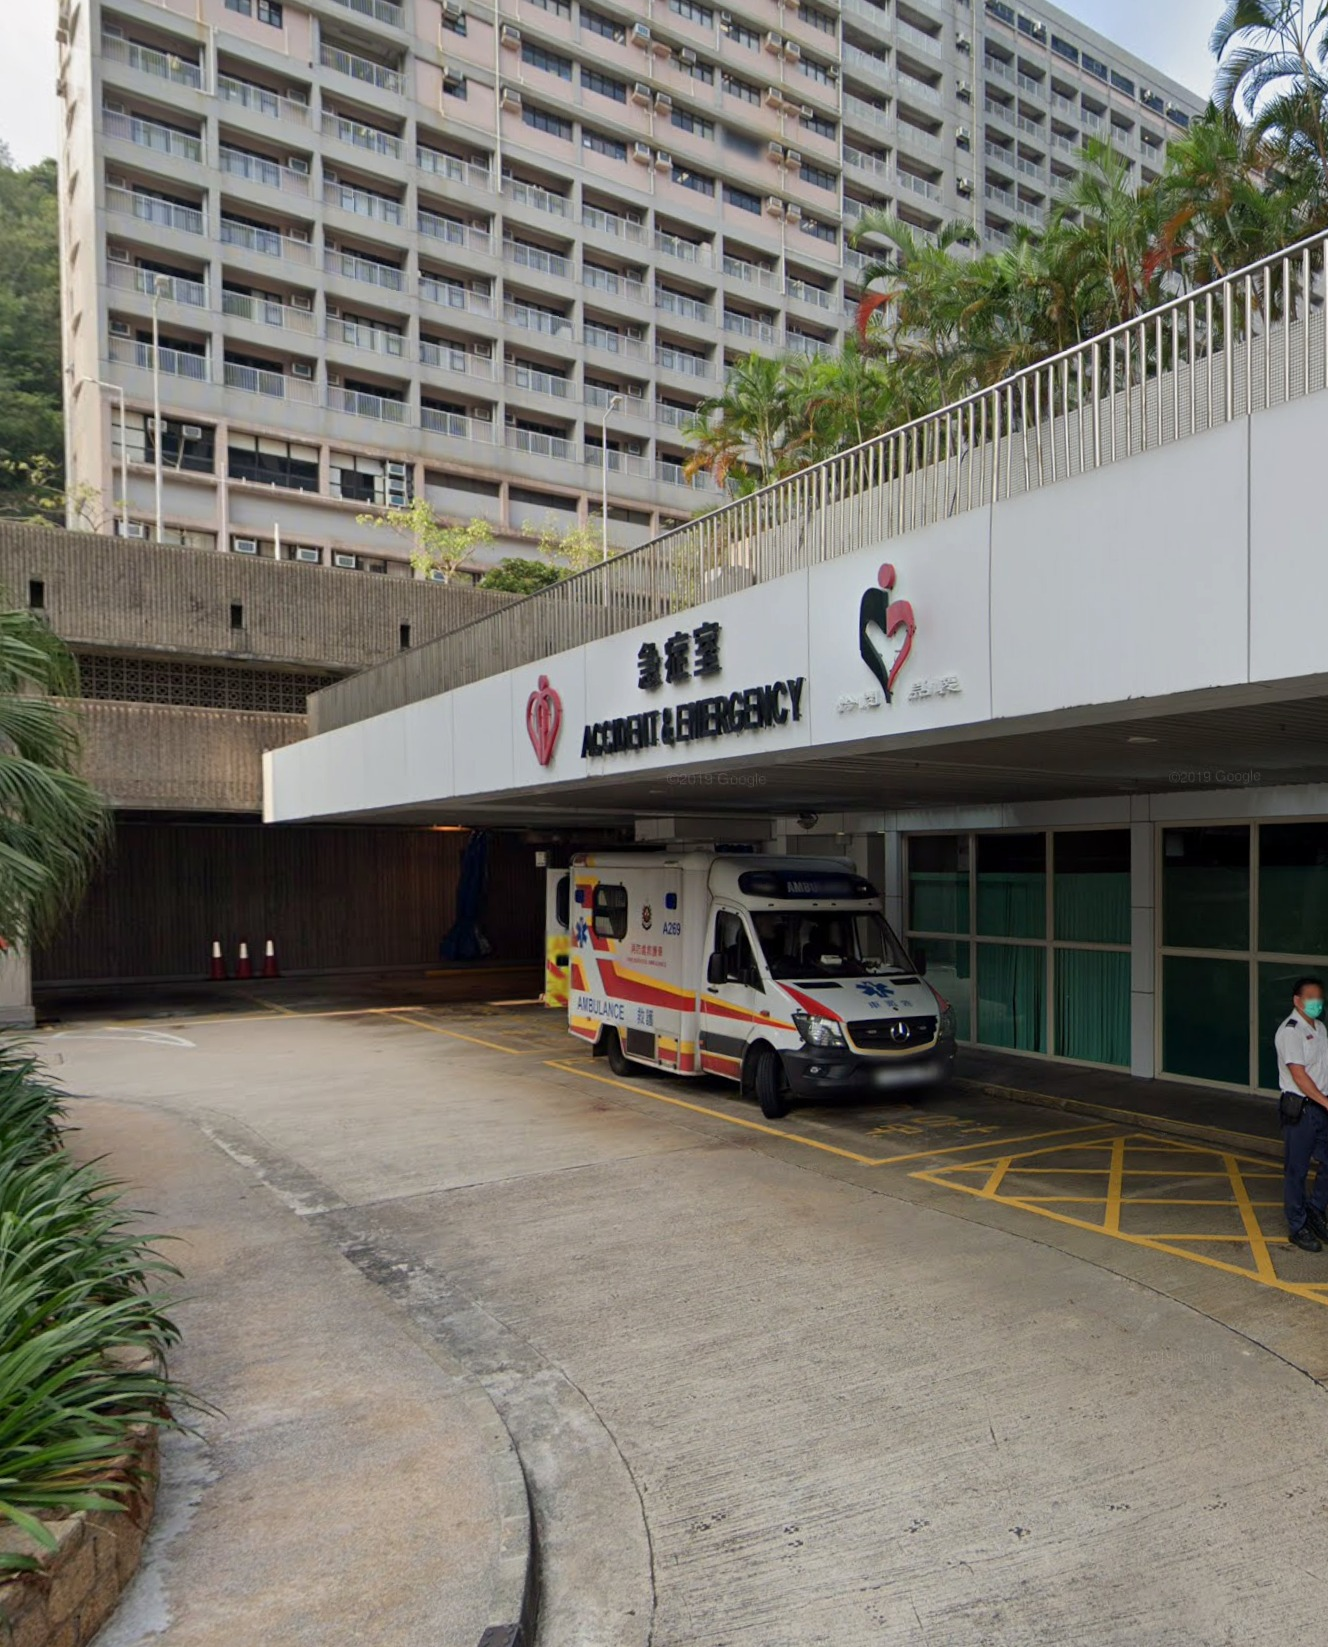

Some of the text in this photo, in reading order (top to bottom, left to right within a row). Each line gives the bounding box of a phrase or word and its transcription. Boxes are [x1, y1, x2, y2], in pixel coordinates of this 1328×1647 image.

[637, 621, 723, 690] 急症室
[581, 709, 661, 758] ACCIDENT
[661, 707, 675, 746] &
[676, 677, 806, 742] EMERGENCY
[663, 921, 681, 937] A269
[578, 996, 625, 1021] AMBULANCE
